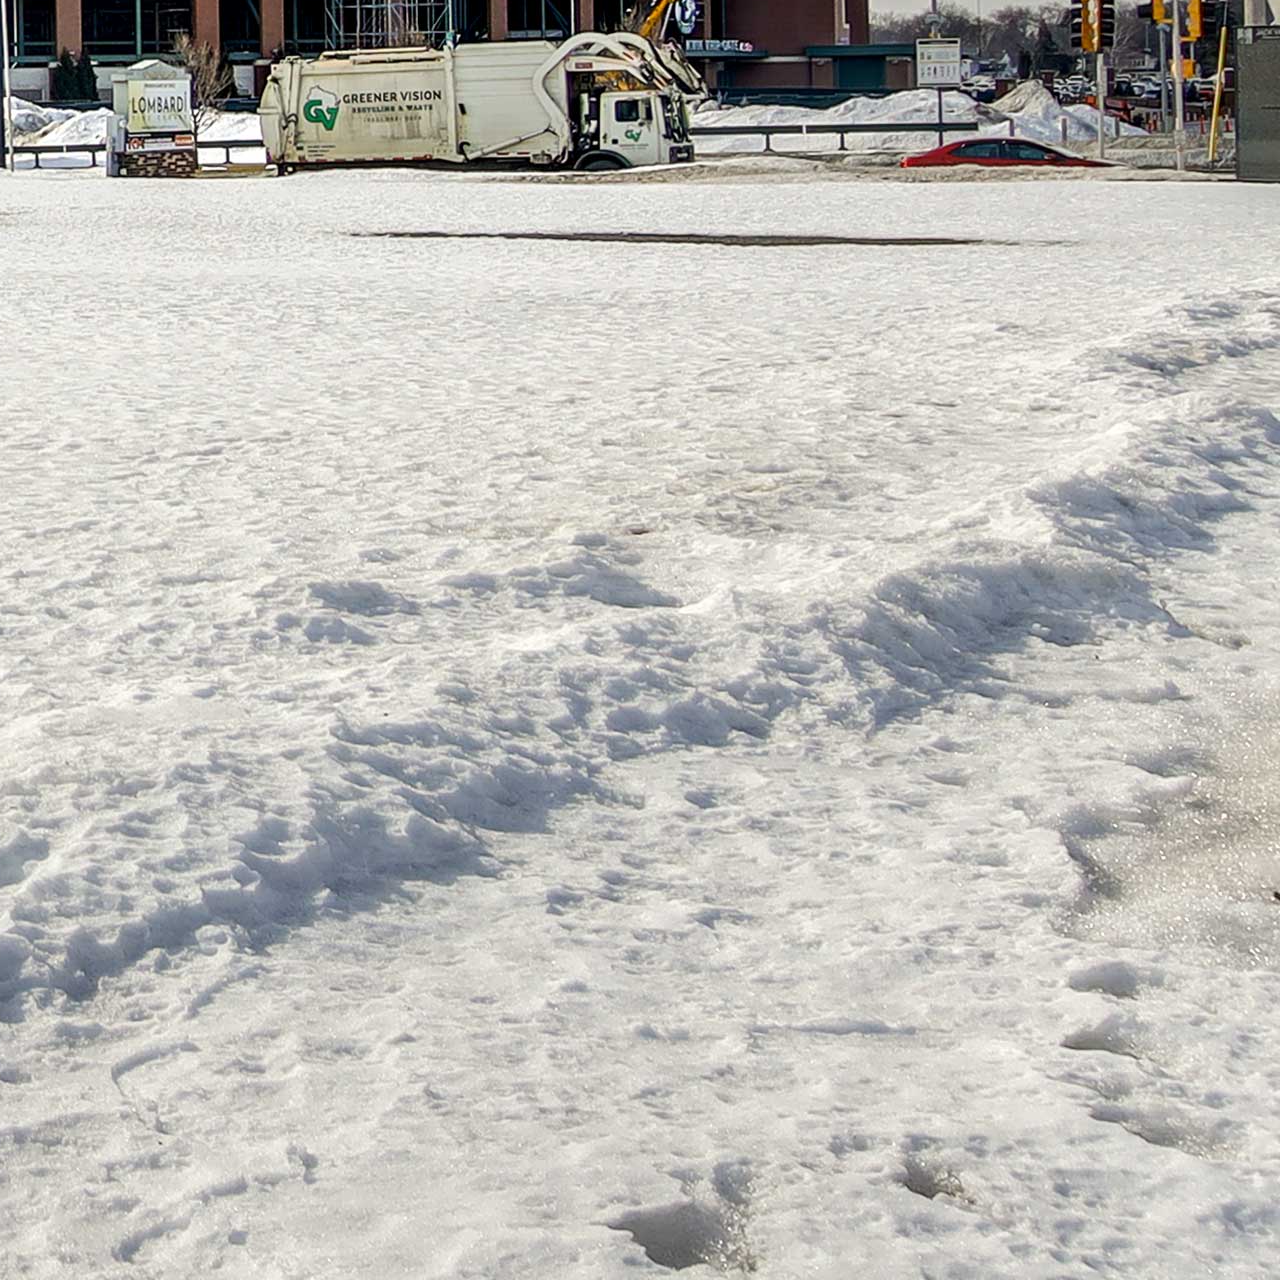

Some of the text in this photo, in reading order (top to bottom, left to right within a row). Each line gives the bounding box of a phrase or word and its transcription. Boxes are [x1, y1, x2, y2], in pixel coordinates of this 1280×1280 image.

[131, 91, 188, 115] LOMBARDI
[342, 89, 442, 104] GREENER VISION
